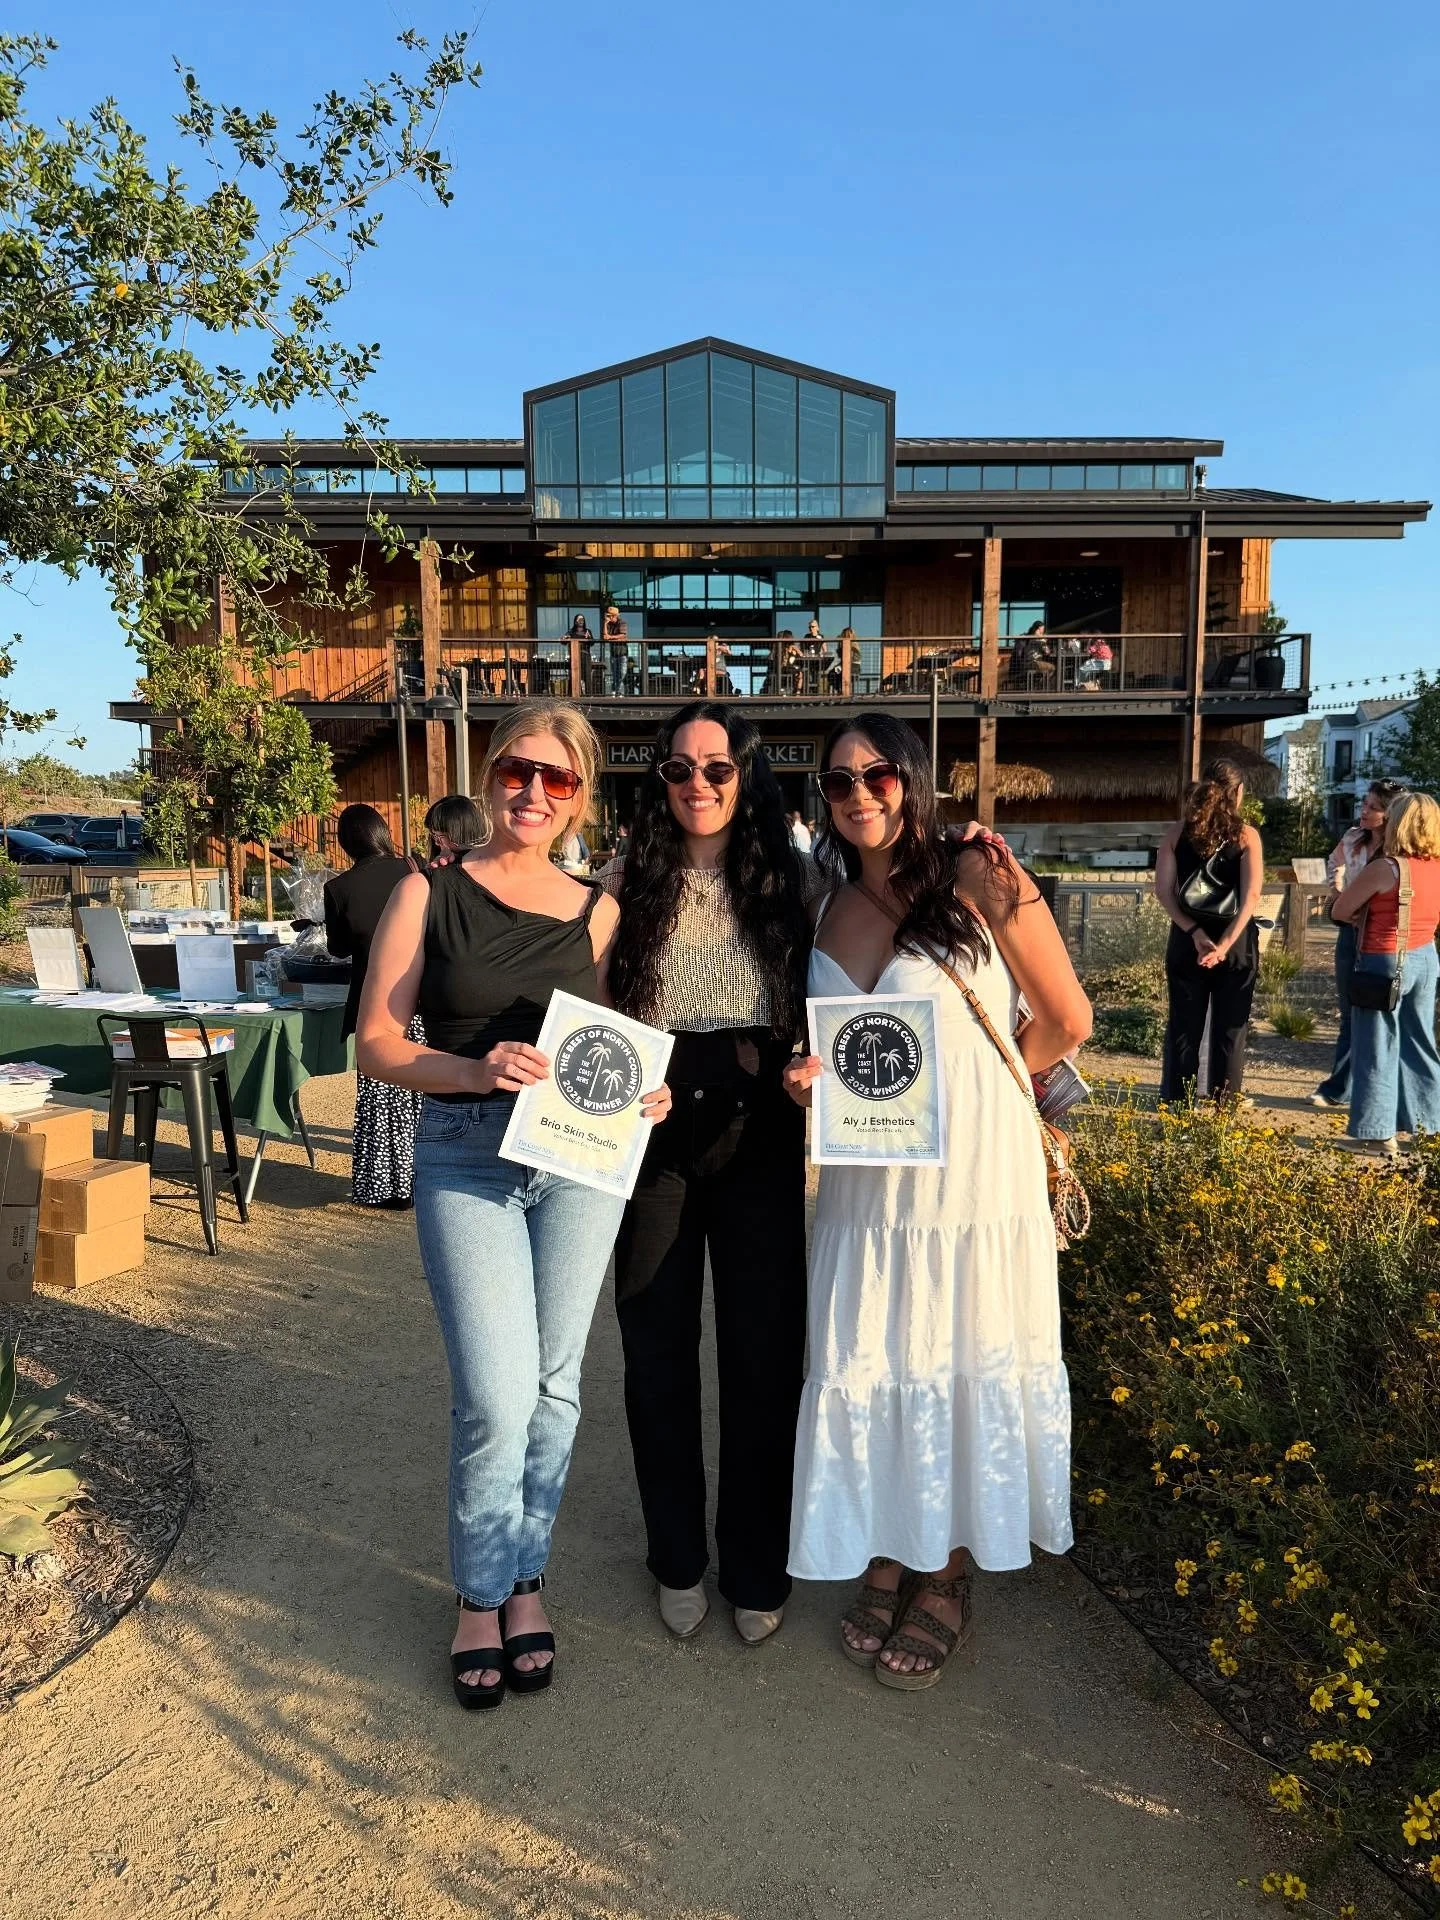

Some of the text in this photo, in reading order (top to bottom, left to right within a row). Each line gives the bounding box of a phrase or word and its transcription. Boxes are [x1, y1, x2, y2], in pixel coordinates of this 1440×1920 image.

[763, 745, 811, 762] RKET
[838, 1018, 917, 1073] THE BEST OF NORTH COUNTY
[560, 1030, 638, 1097] THE BEST OF NORTH COUNTY
[562, 1080, 623, 1110] 2025 WINNER
[847, 1075, 910, 1095] 2025 WINNER
[540, 1117, 618, 1150] Brio Skin Studio
[843, 1117, 915, 1127] Aly J Esthetics
